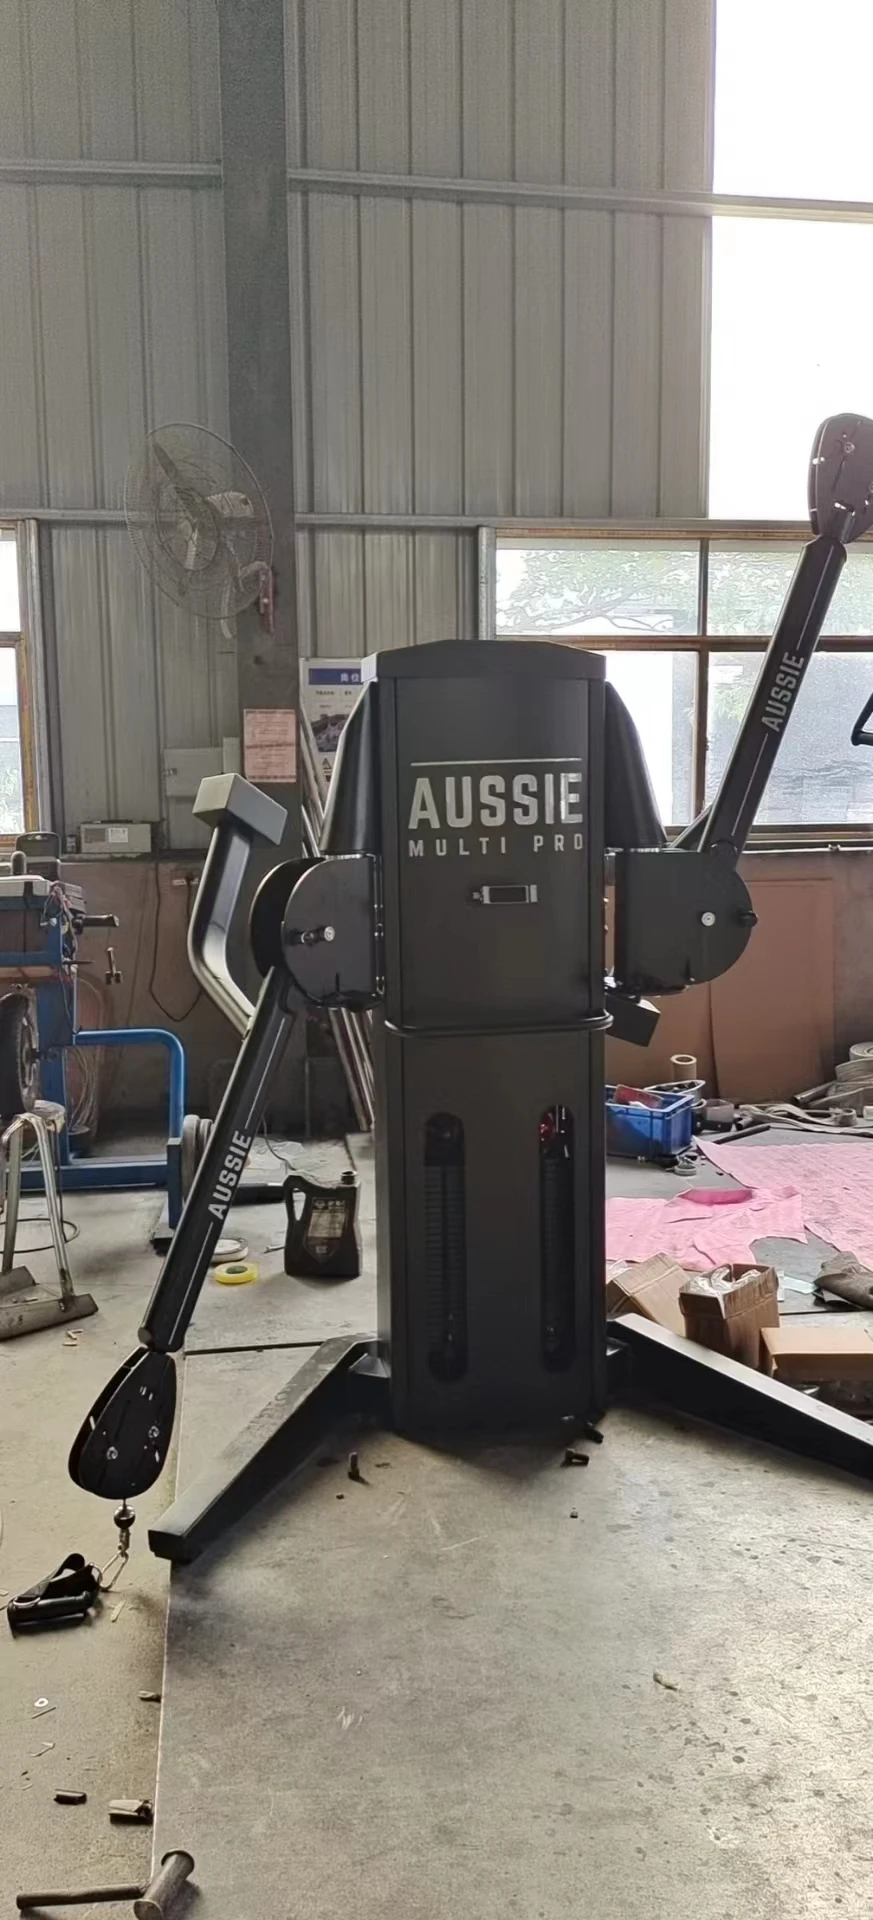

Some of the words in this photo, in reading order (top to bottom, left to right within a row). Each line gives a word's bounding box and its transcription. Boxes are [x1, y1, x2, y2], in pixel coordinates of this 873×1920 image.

[761, 652, 804, 732] AUSSIE
[408, 773, 583, 829] AUSSIE
[409, 837, 506, 857] MULTI
[533, 833, 583, 853] PRO
[207, 1130, 252, 1220] AUSSIE
